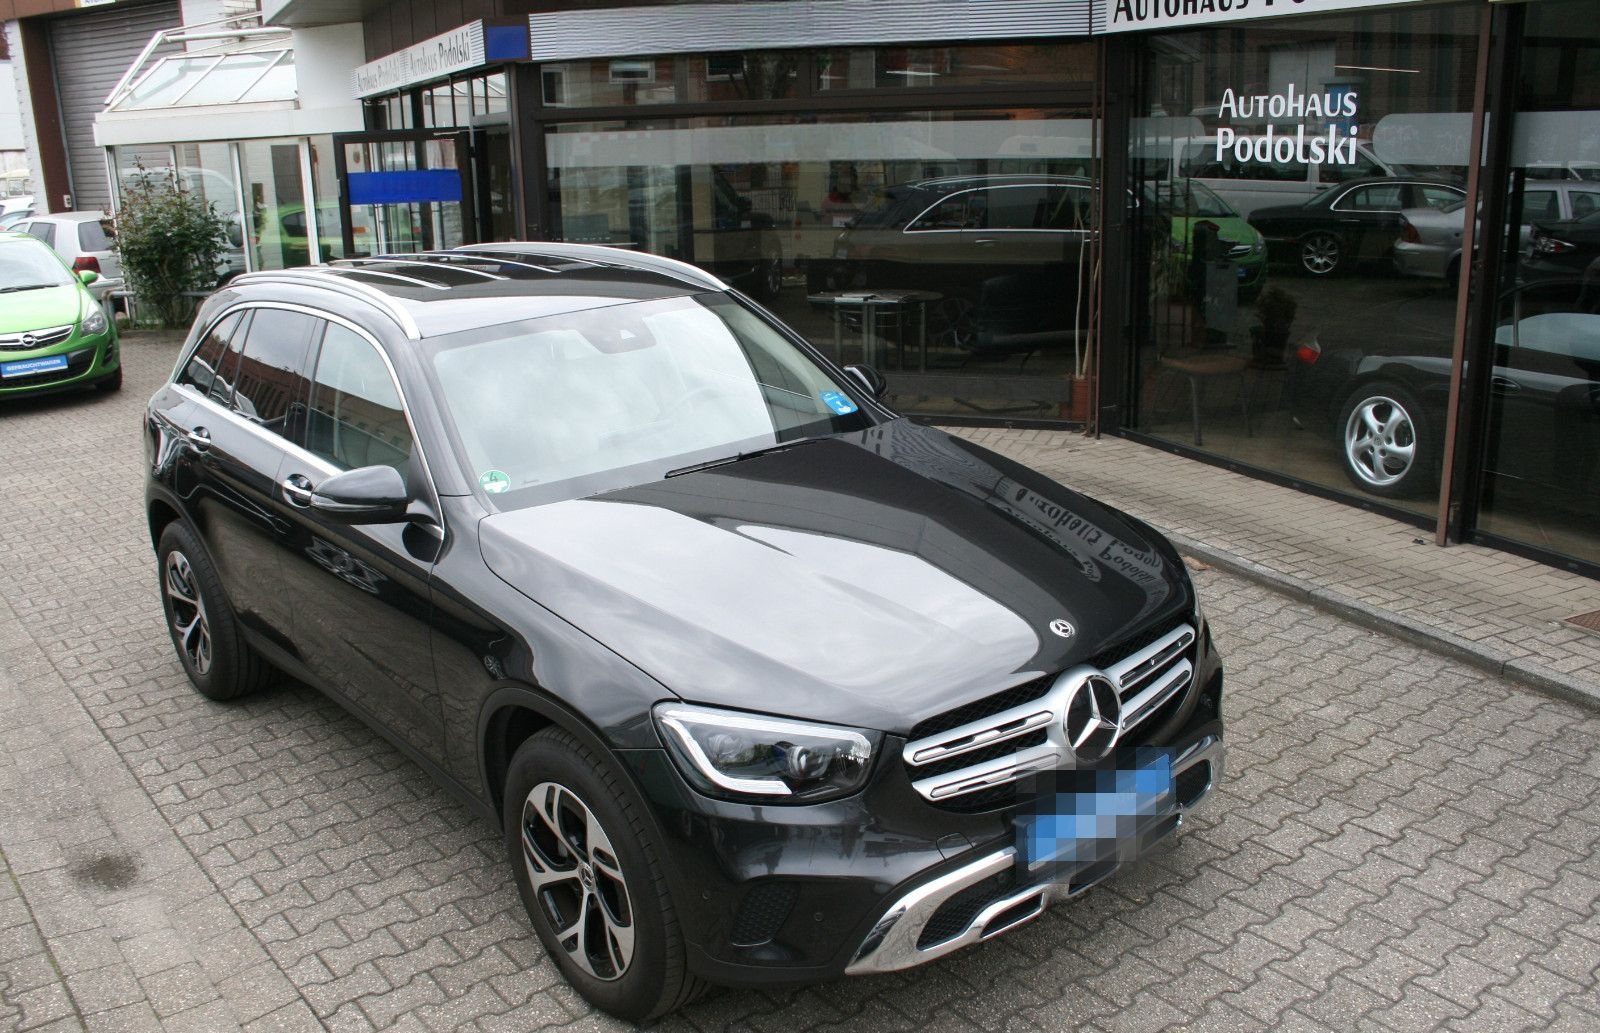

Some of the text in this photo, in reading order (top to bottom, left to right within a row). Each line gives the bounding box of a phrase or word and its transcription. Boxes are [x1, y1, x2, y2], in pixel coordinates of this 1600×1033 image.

[439, 32, 471, 68] Podolski
[1216, 124, 1358, 165] Podolski
[489, 472, 498, 482] 4
